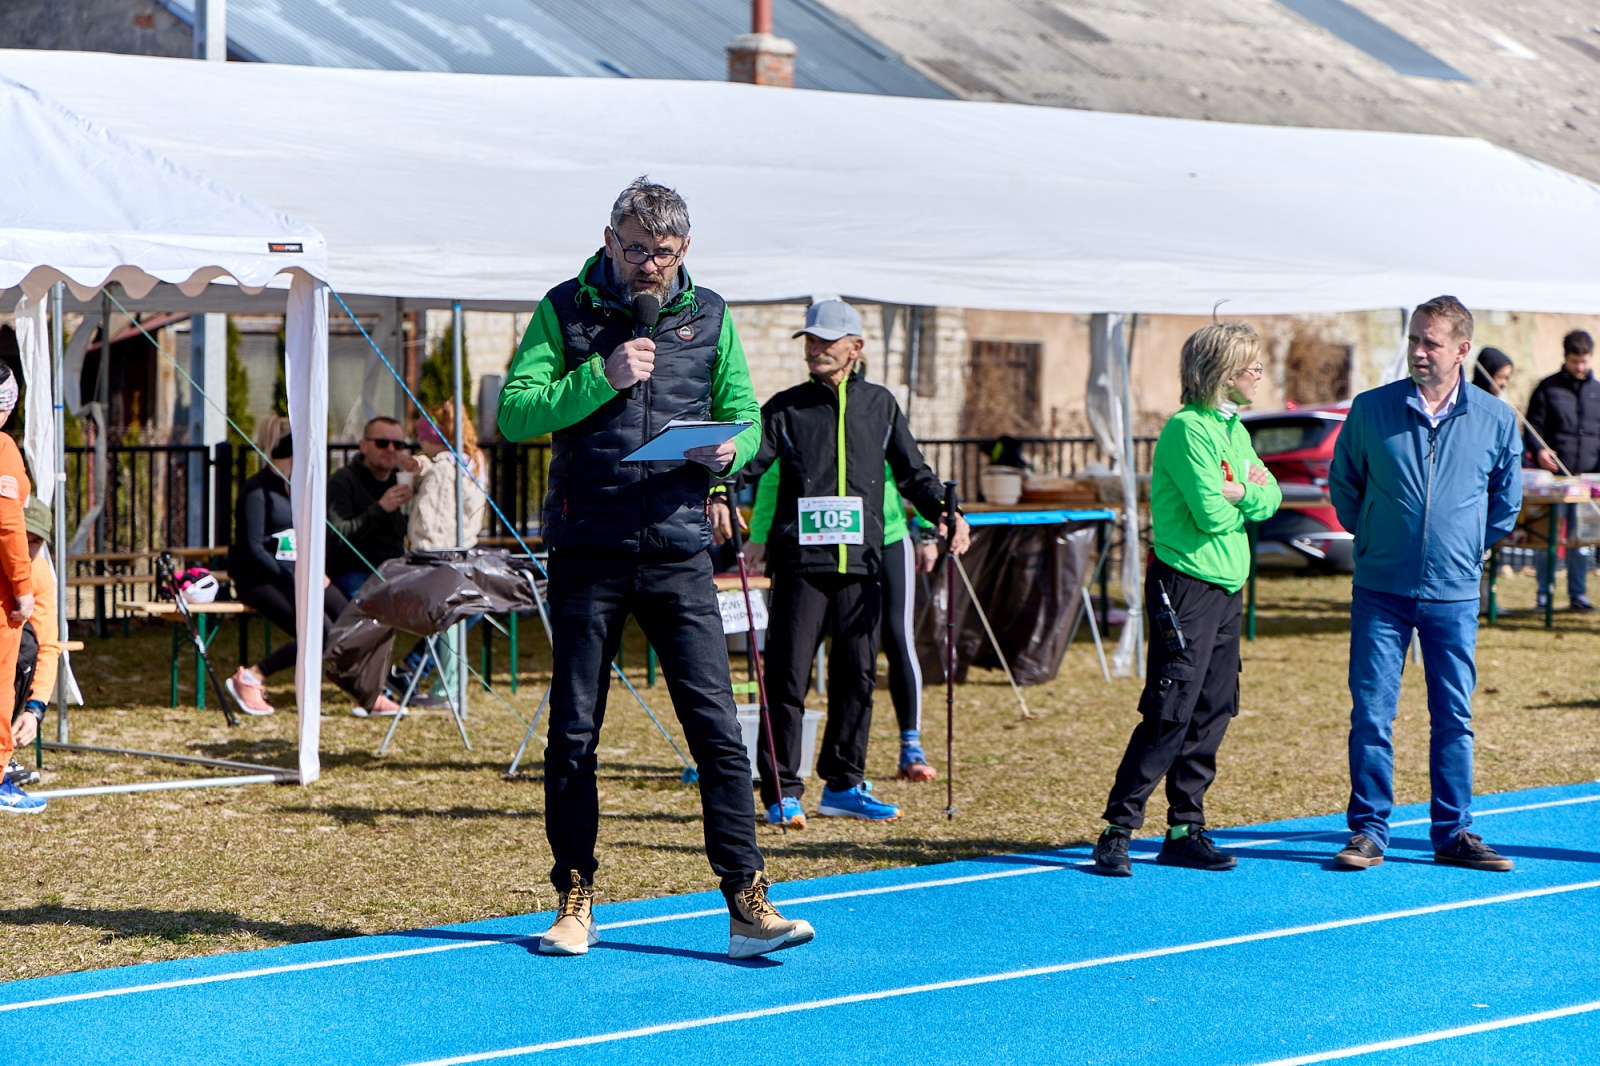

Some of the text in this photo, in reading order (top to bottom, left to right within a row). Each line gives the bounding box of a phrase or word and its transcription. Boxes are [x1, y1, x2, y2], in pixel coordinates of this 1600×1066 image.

[810, 510, 853, 528] 105
[721, 600, 756, 610] ZWRT
[722, 611, 763, 623] CHIPW
